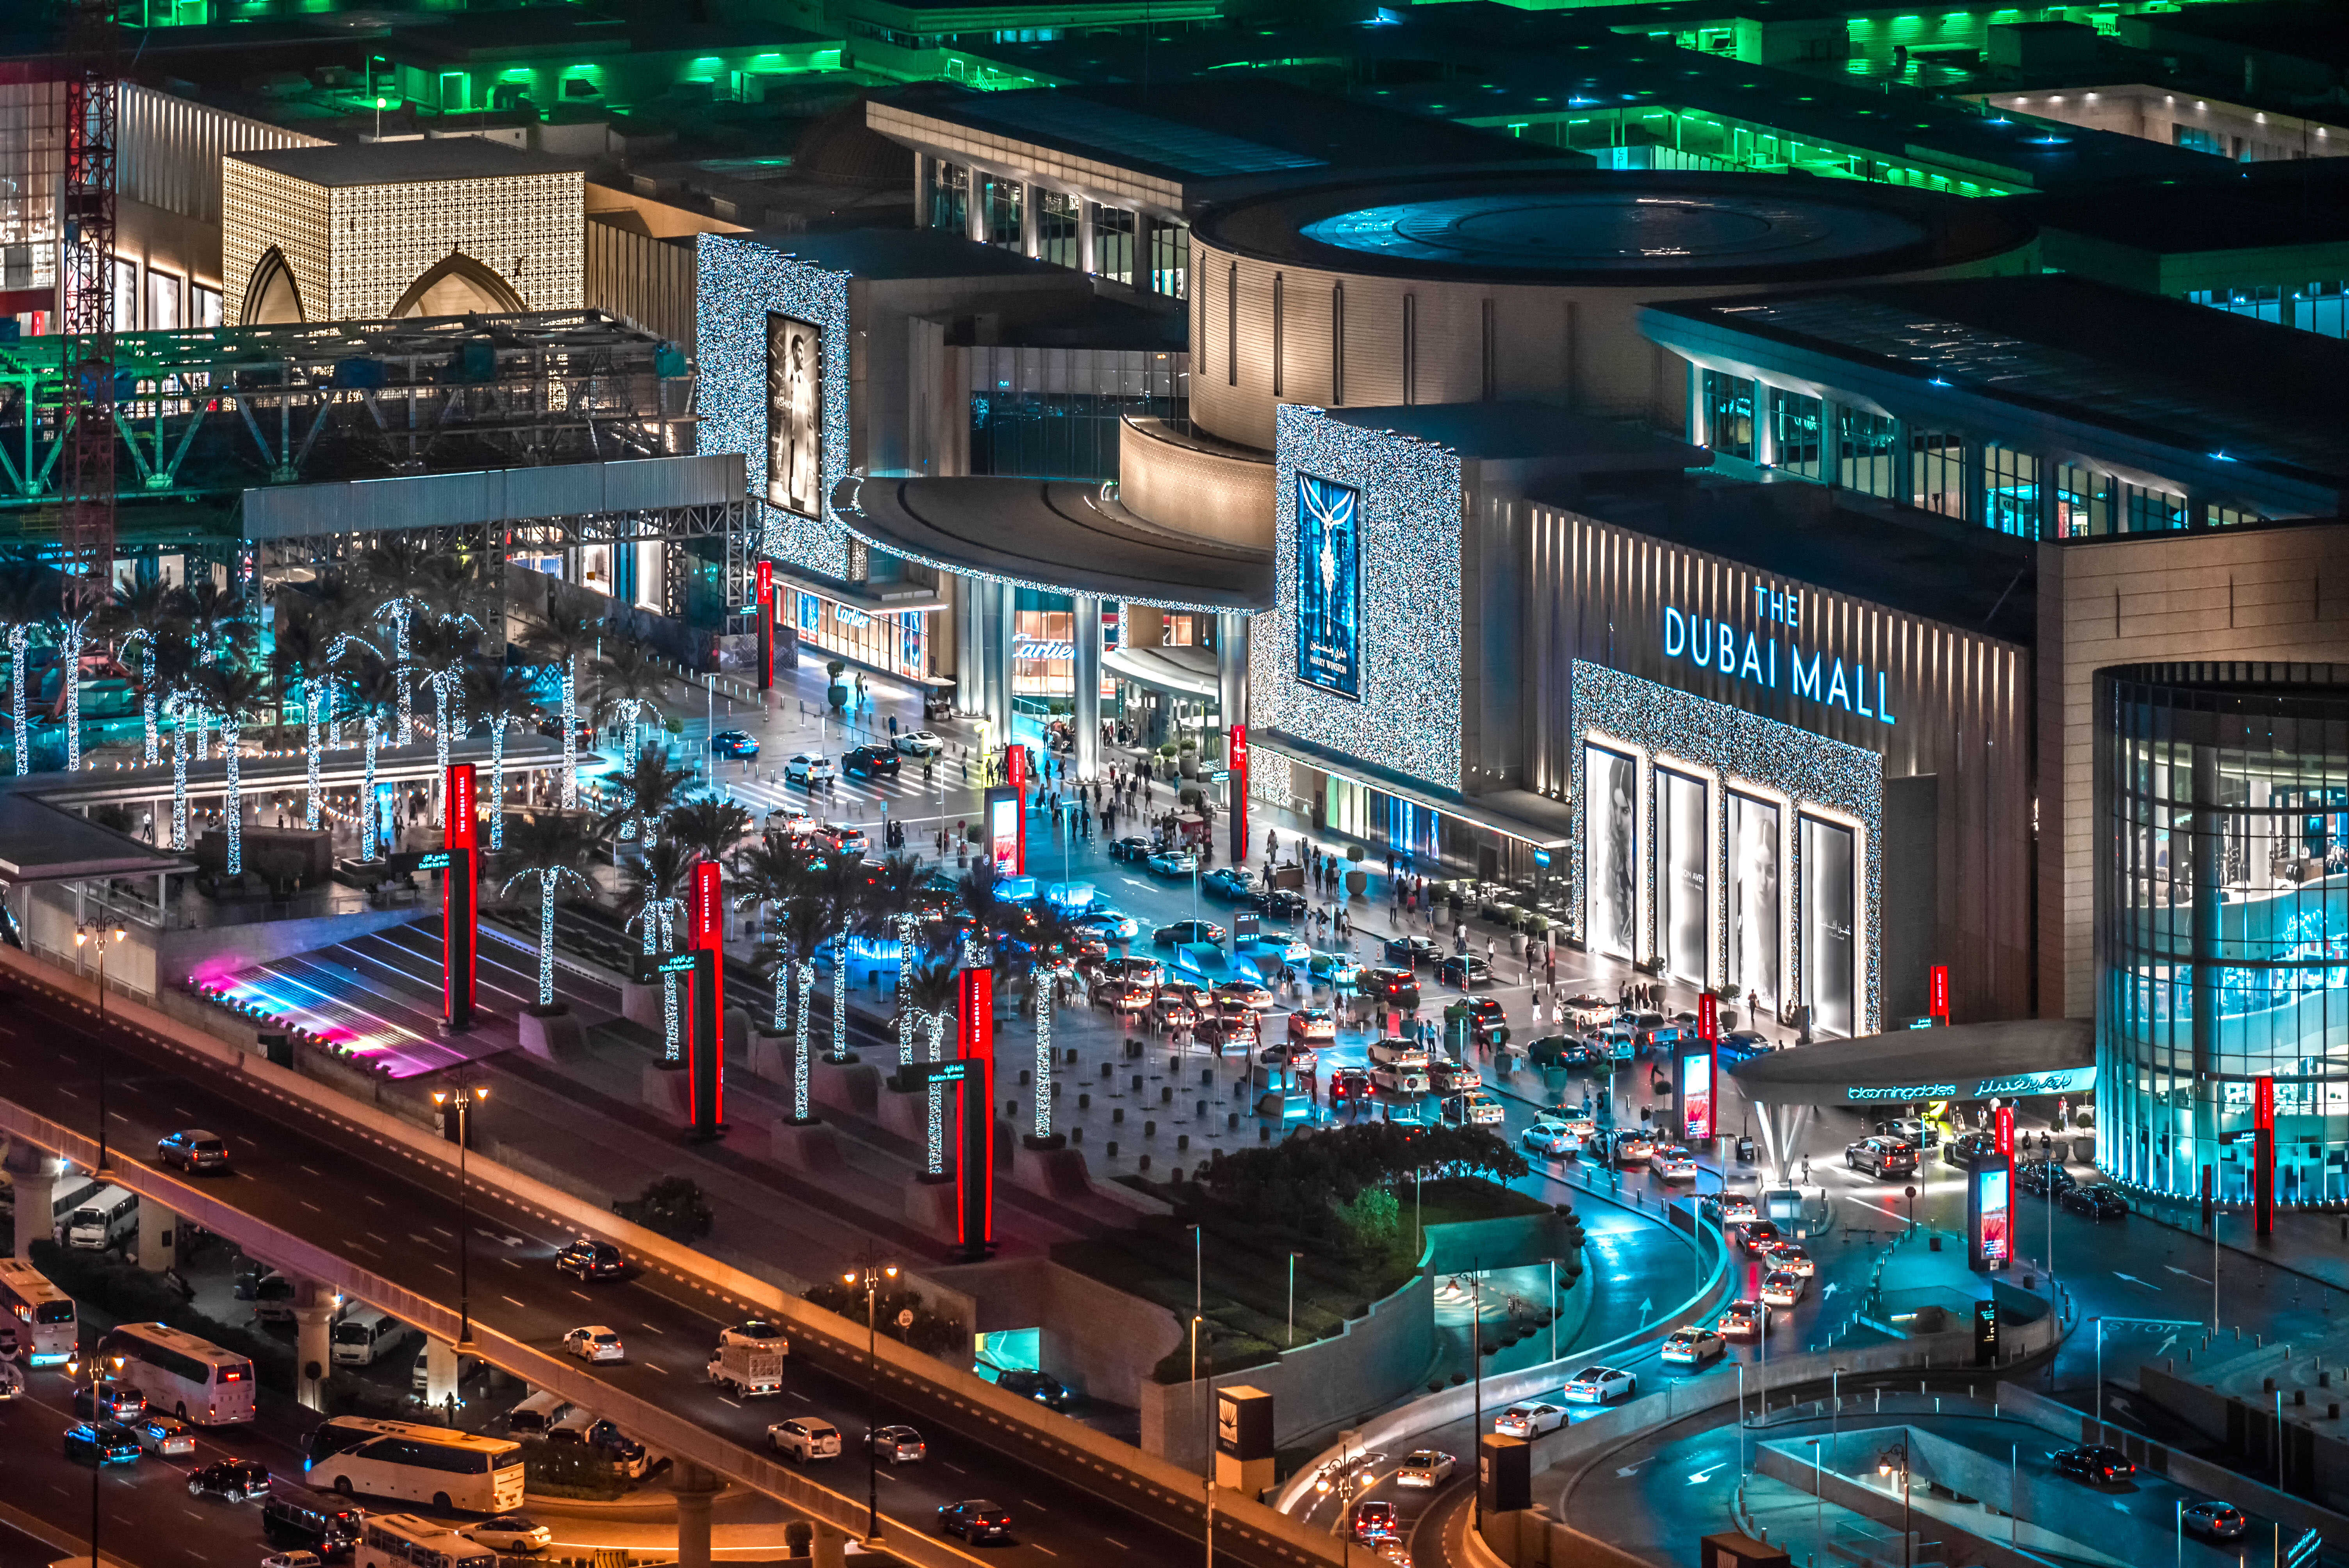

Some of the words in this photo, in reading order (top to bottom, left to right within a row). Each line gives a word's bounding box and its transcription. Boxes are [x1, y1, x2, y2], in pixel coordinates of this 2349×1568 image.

[835, 603, 870, 629] Cartier
[1754, 586, 1798, 626] THE
[1334, 646, 1347, 661] هاري
[1310, 654, 1325, 667] HARRY
[1326, 660, 1347, 674] WINSTON
[1665, 606, 1776, 688] DUBAI
[1792, 644, 1895, 724] MALL
[673, 963, 694, 971] Aquarium
[2107, 1322, 2181, 1333] STOP
